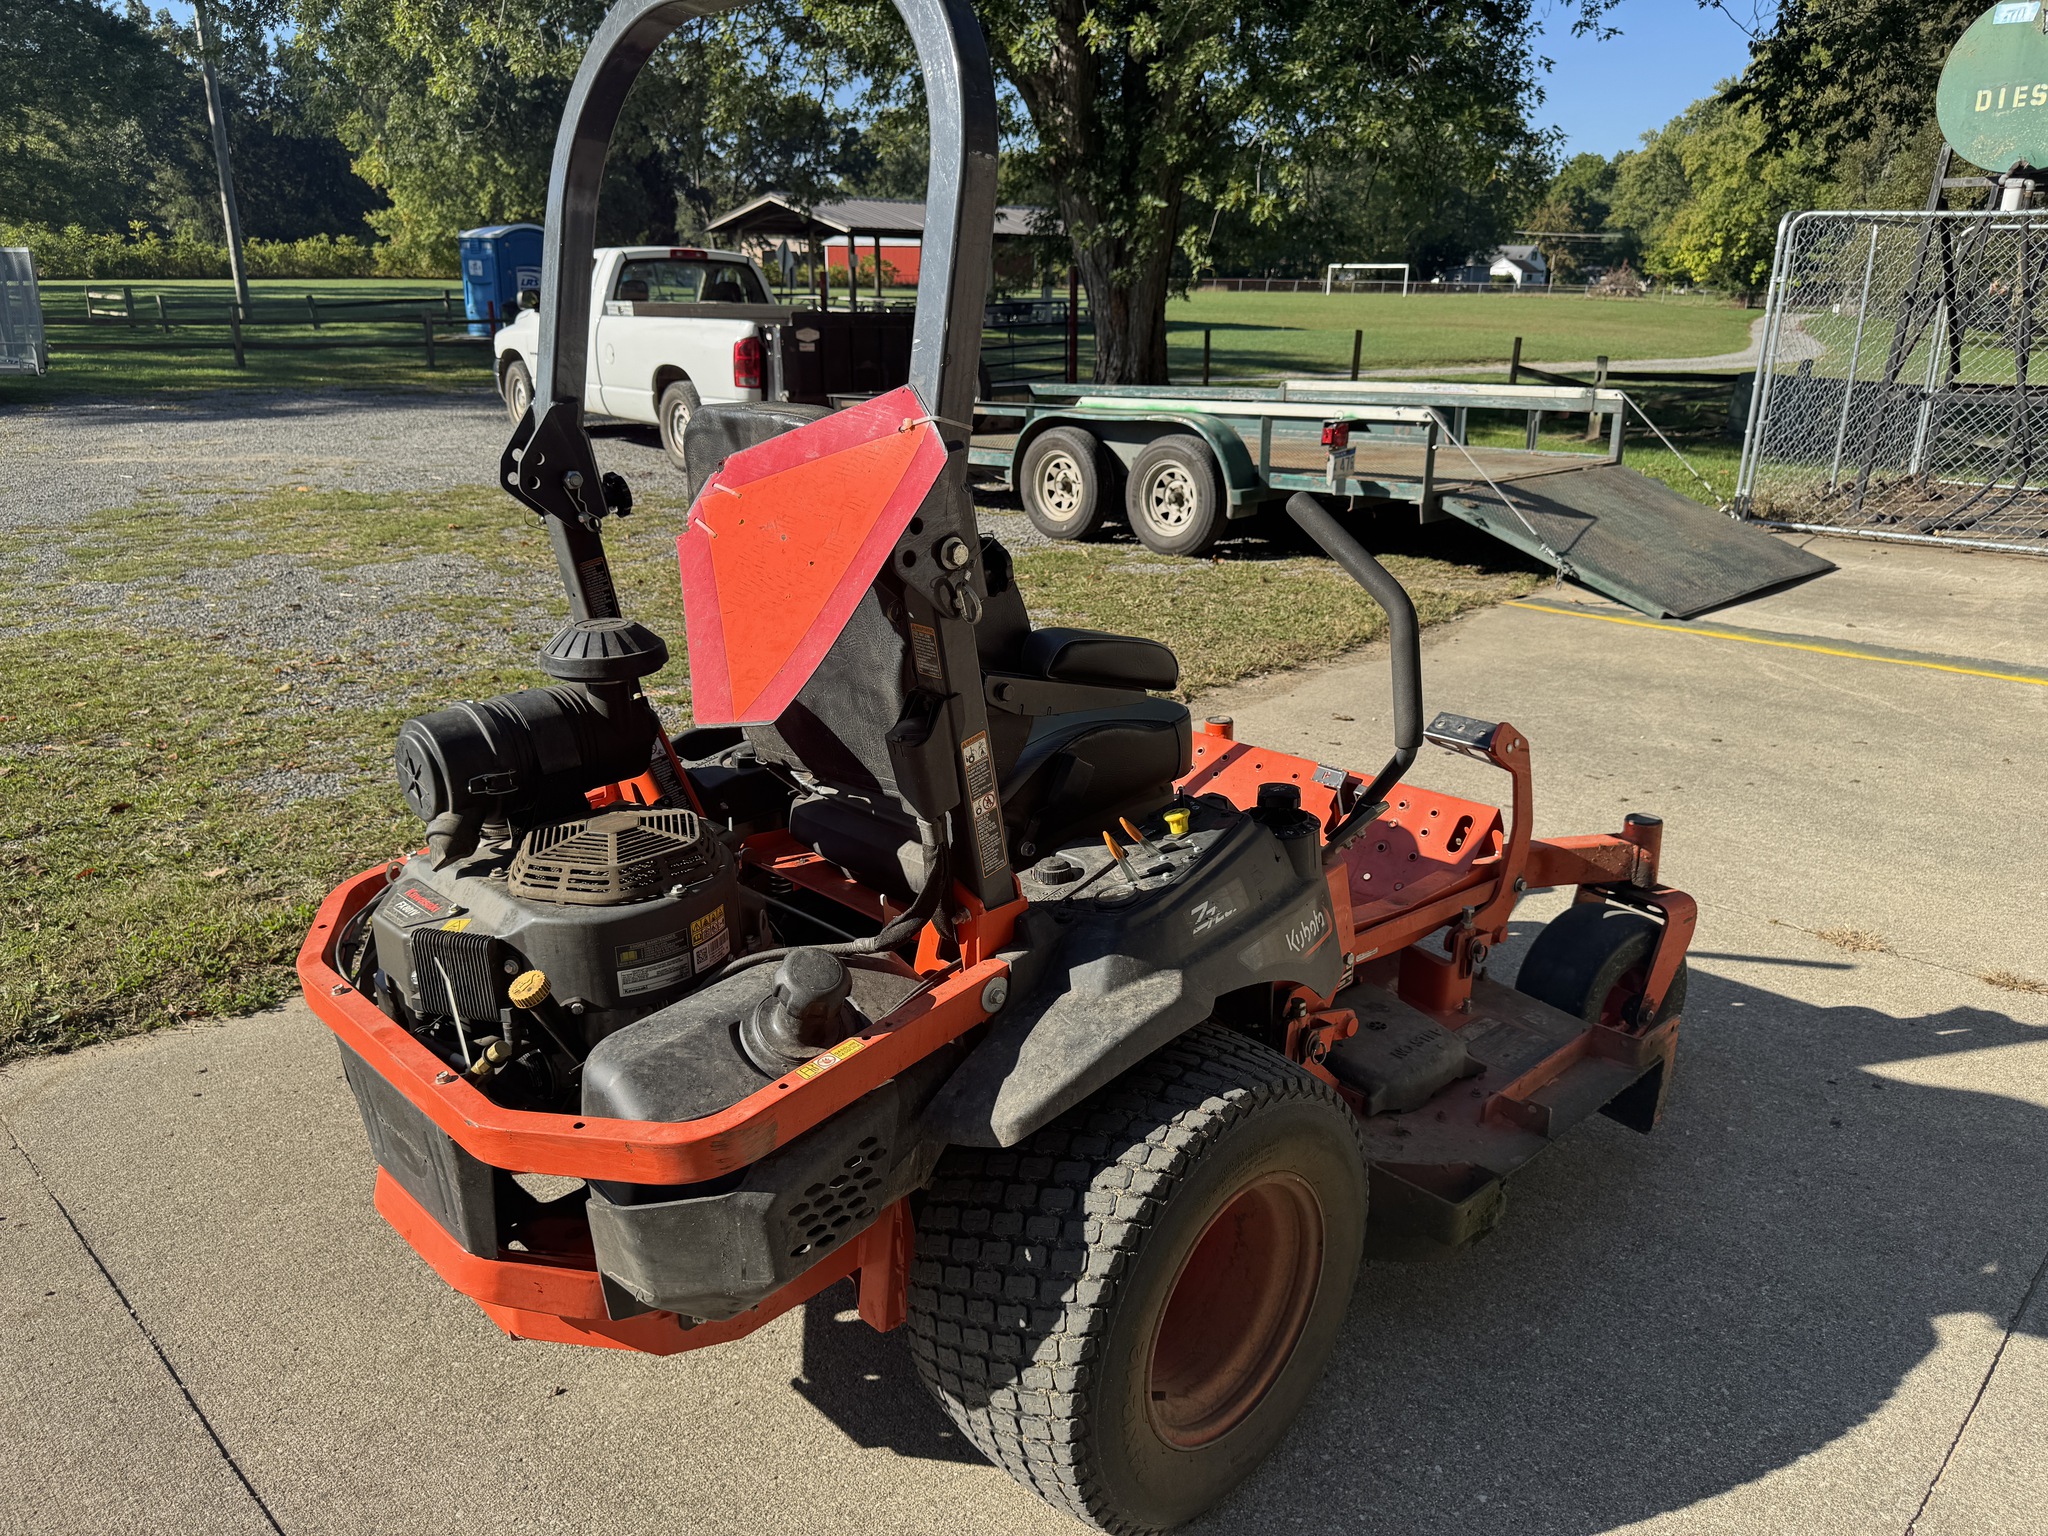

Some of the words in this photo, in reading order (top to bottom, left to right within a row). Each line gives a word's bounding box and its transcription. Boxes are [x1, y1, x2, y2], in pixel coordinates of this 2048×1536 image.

[521, 278, 539, 287] LRS
[404, 888, 443, 913] Kawasaki
[1285, 910, 1325, 952] Kubota
